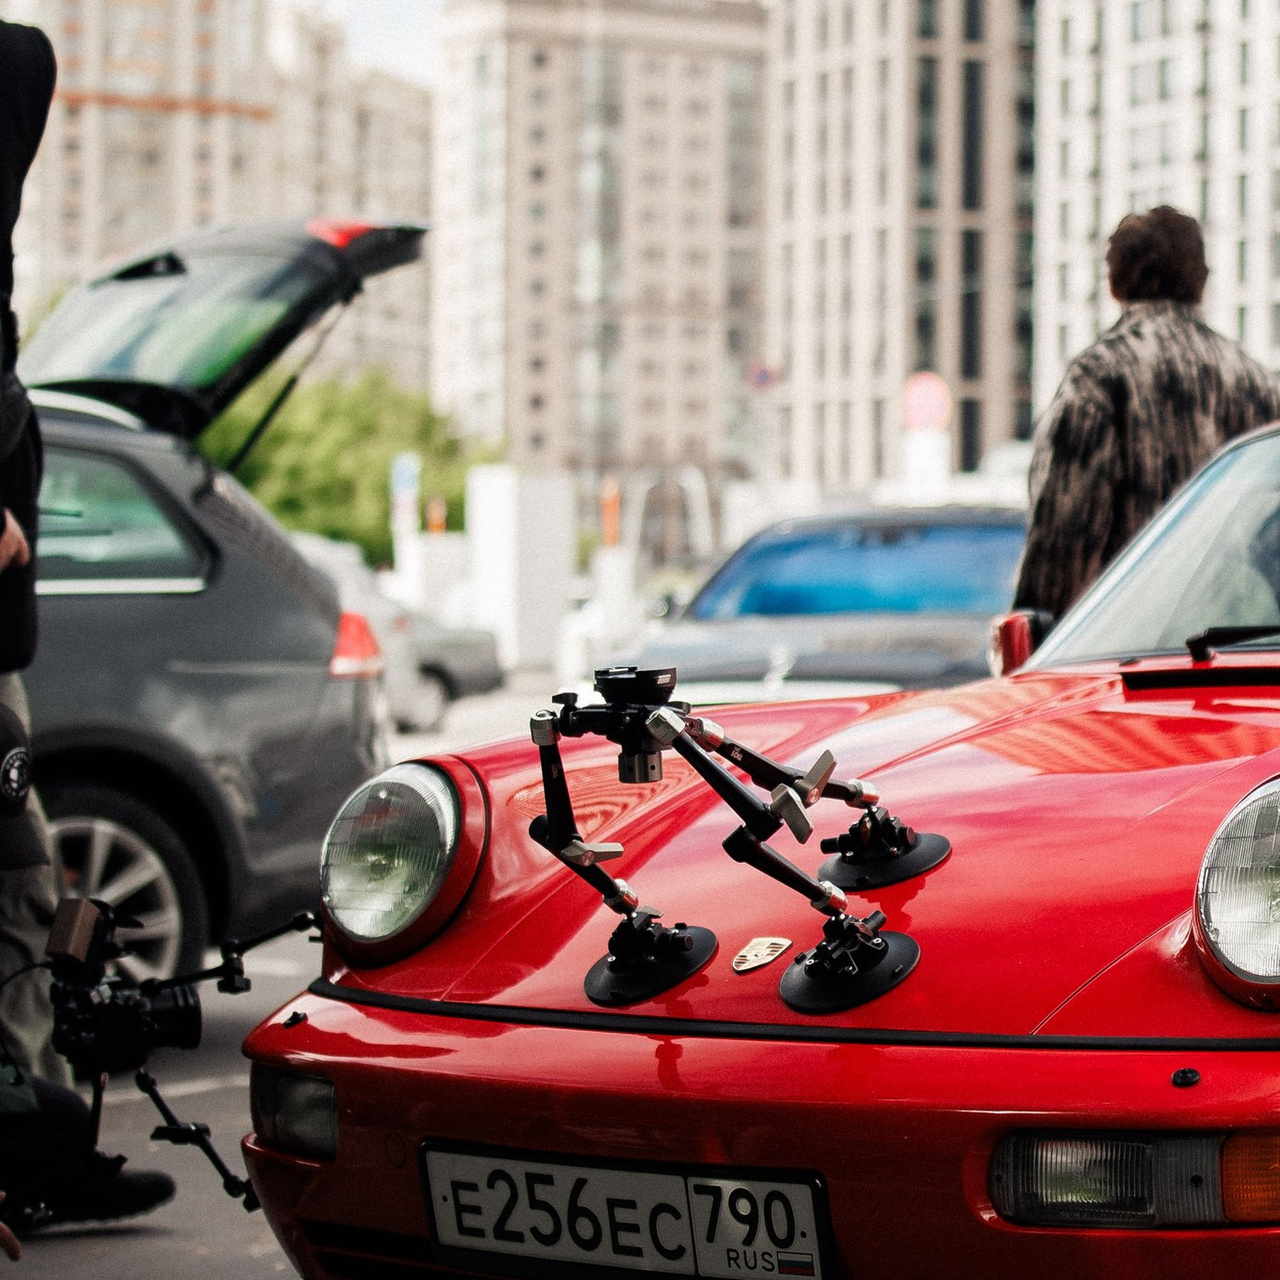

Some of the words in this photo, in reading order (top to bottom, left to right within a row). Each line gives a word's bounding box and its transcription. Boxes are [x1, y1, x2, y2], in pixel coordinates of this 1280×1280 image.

[451, 1169, 686, 1260] E256EC
[693, 1184, 795, 1249] 790
[727, 1248, 775, 1272] RUS
